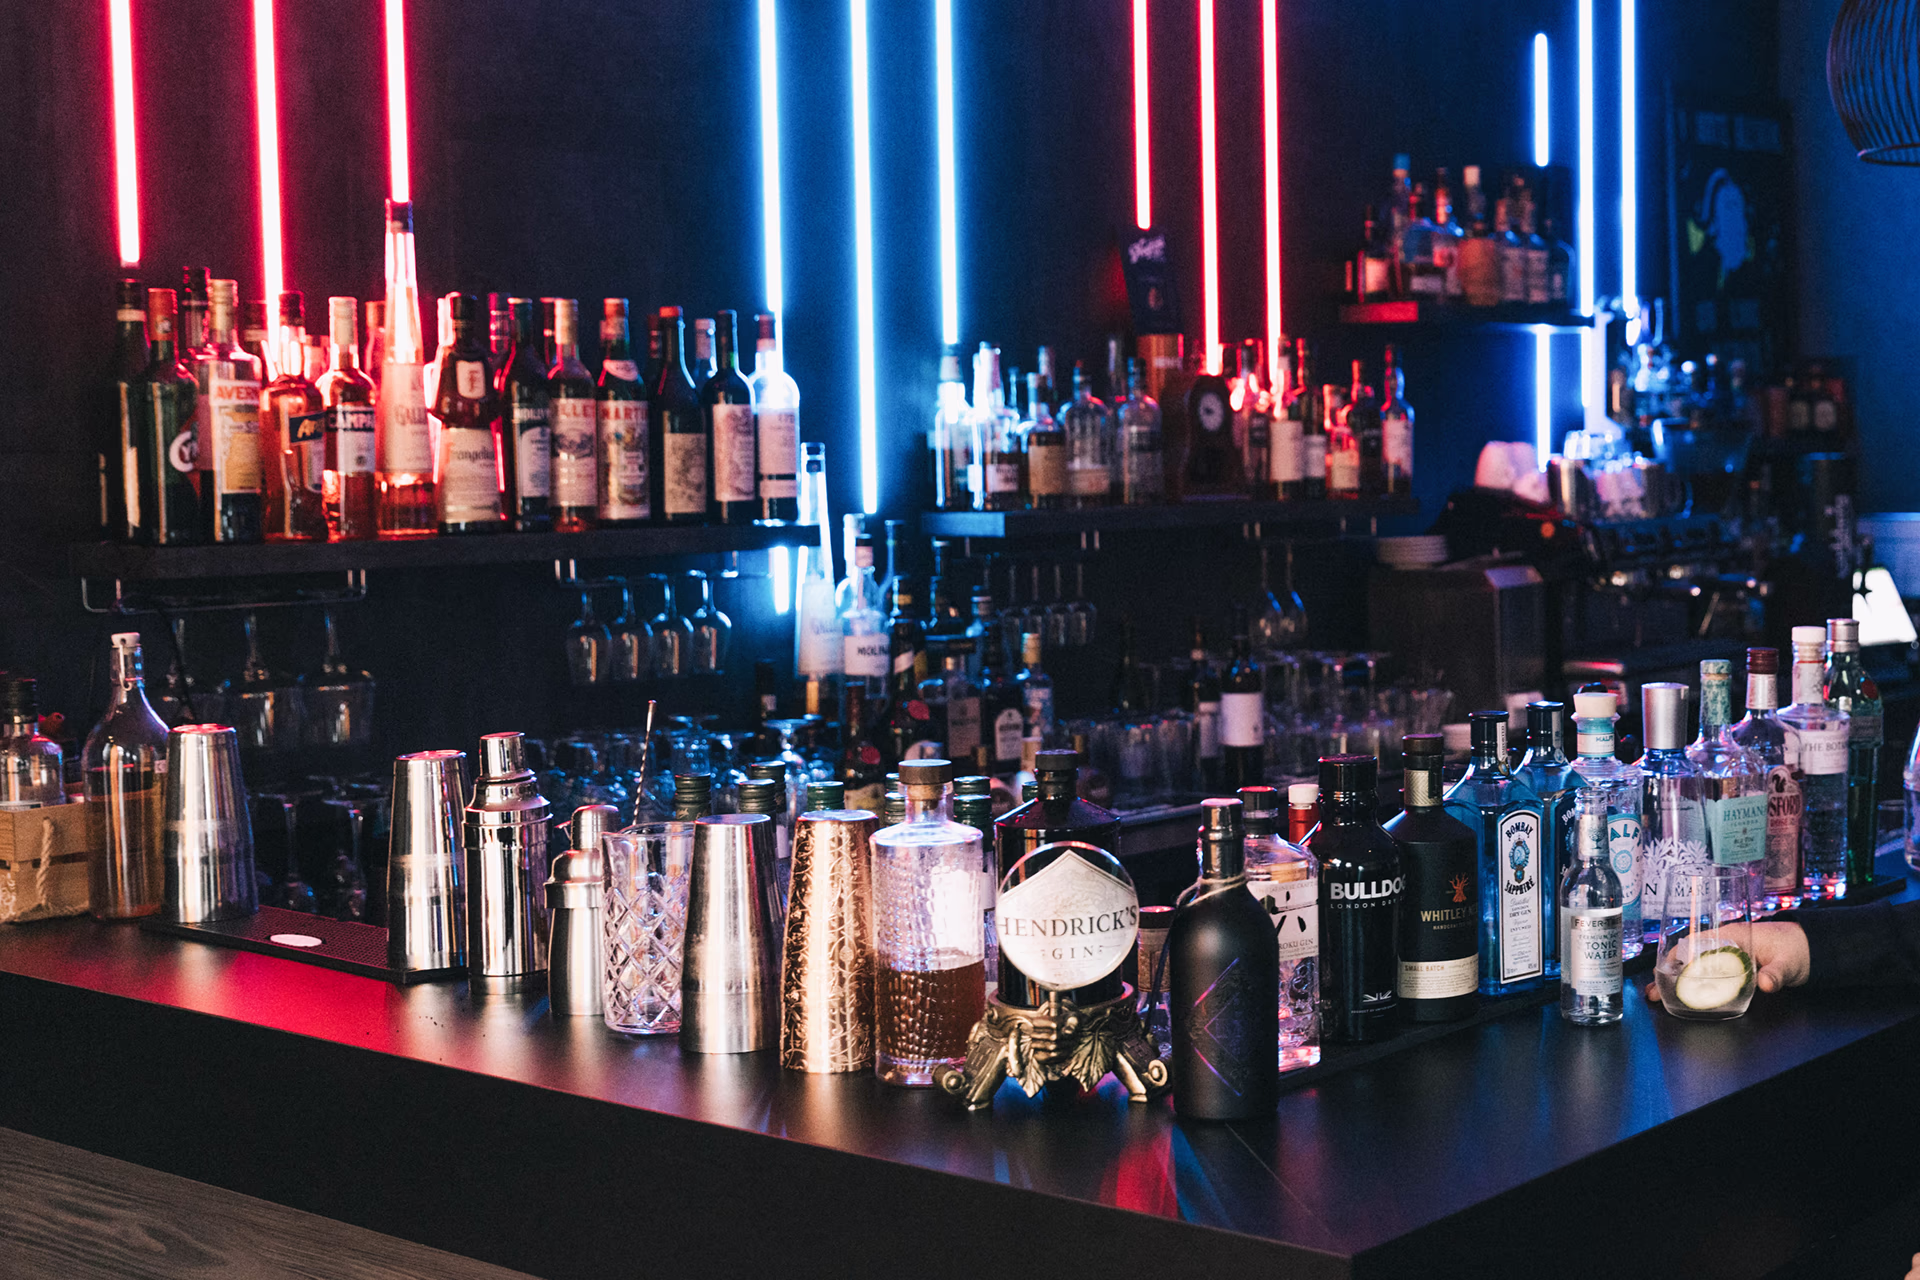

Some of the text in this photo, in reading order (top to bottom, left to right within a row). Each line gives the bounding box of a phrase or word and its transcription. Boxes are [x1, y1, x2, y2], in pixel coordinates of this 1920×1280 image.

[1505, 822, 1533, 838] BOMBAY
[1504, 879, 1536, 895] SAPPHIRE
[997, 905, 1137, 937] HENDRICK'S
[1420, 907, 1466, 922] WHITLEY
[1300, 938, 1313, 946] GIN
[1586, 940, 1616, 950] TONIC
[1052, 945, 1094, 960] GIN
[1584, 950, 1618, 960] WATER
